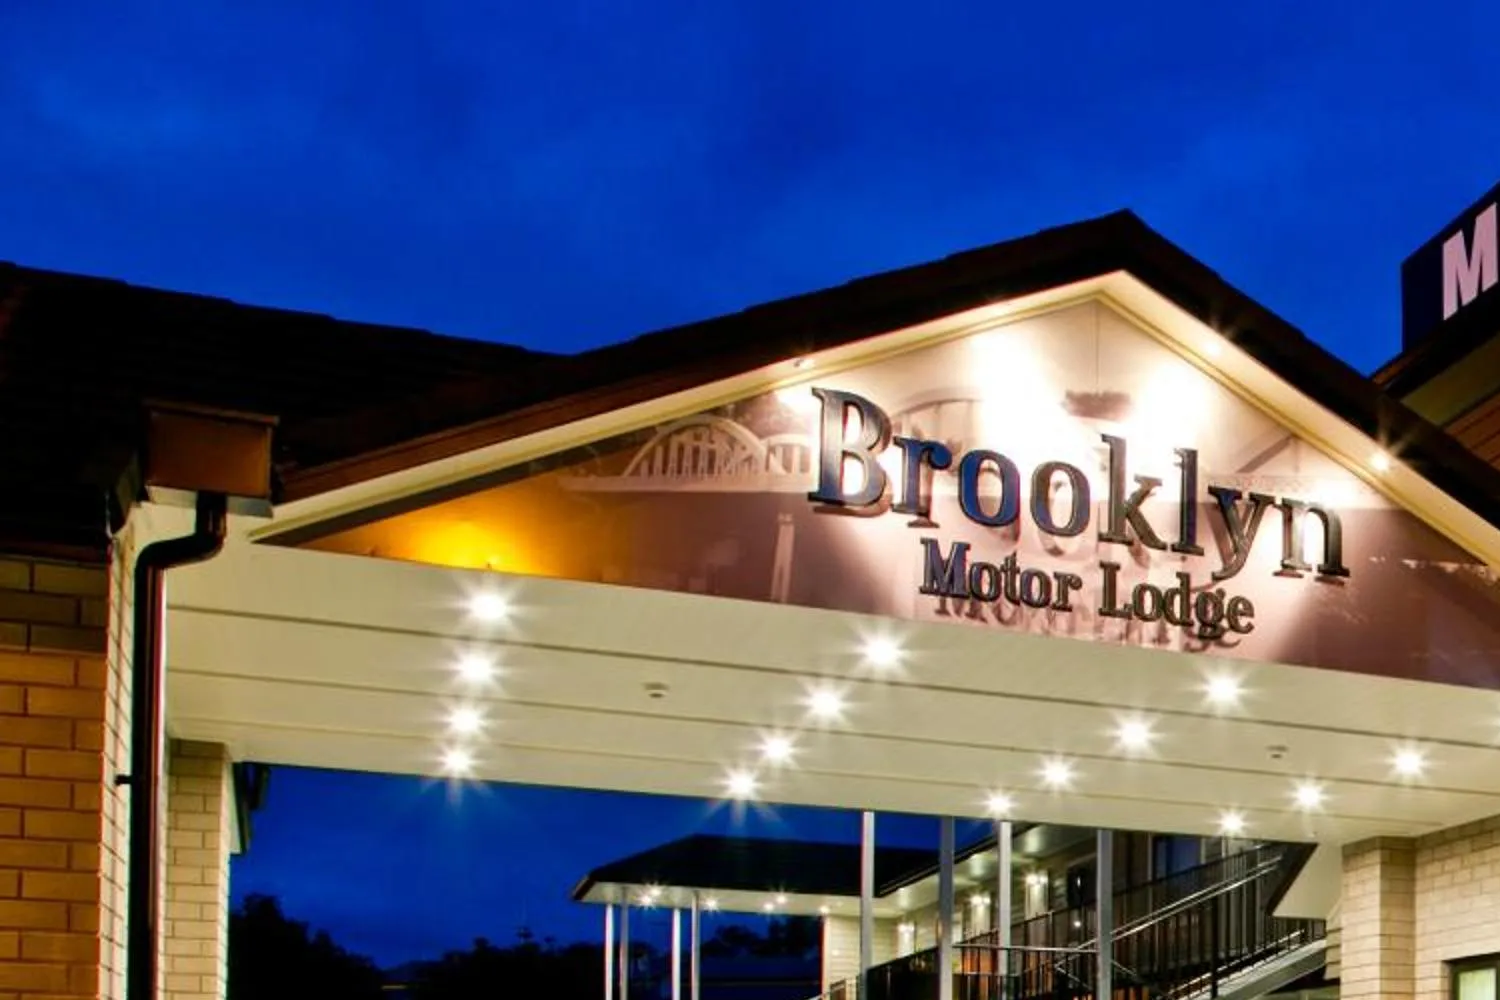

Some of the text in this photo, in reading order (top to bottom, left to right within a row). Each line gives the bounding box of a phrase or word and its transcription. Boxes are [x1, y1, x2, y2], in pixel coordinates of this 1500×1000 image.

[808, 387, 1351, 582] Brooklyn
[920, 537, 1254, 639] Motor Lodge
